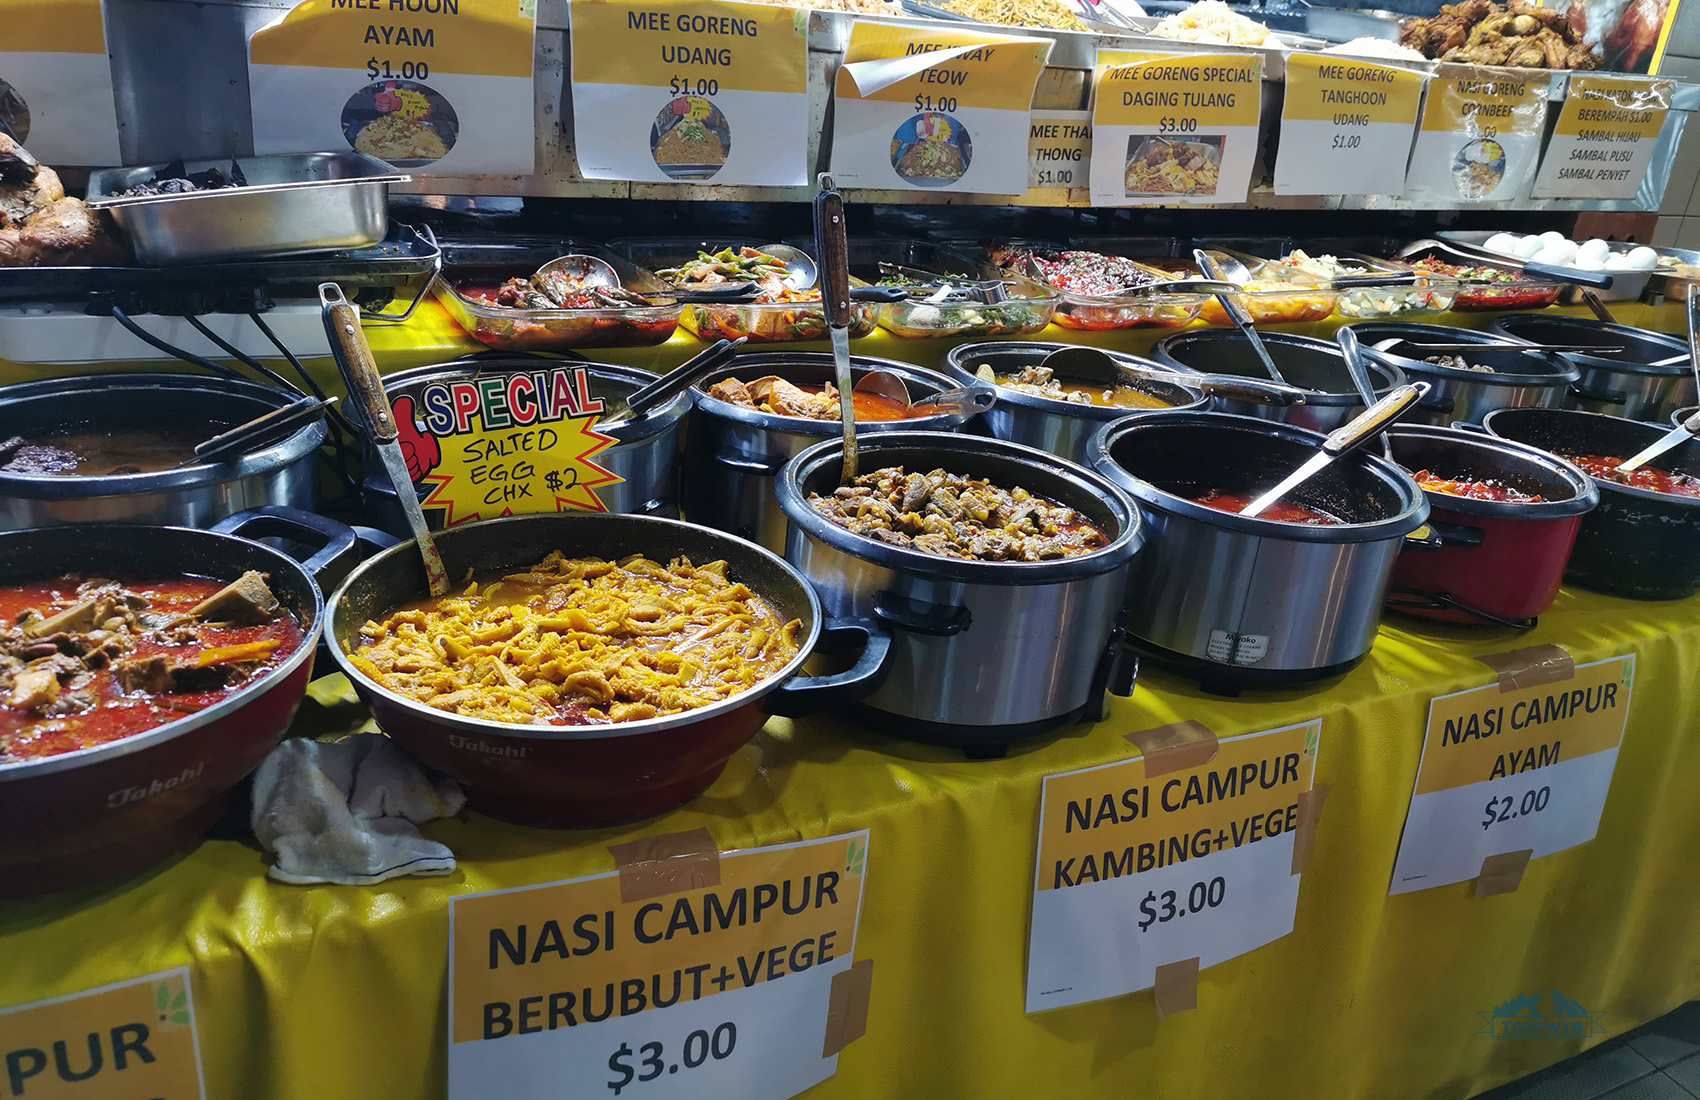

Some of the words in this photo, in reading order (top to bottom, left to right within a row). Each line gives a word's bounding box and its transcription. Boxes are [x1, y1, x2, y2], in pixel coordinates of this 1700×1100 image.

[628, 11, 670, 31] MEE
[677, 14, 757, 37] GORENG
[364, 25, 435, 47] AYAM
[662, 45, 731, 66] UDANG
[947, 45, 995, 62] WAY
[367, 57, 429, 81] $1.00
[920, 68, 968, 86] TEOW
[1110, 66, 1142, 80] MEE
[1142, 66, 1199, 81] GORENG
[1203, 67, 1252, 83] SPECIAL
[1318, 65, 1344, 79] MEE
[1346, 67, 1397, 82] GORENG
[670, 75, 718, 97] $1.00
[1457, 81, 1481, 93] NASI
[1482, 82, 1525, 96] GORENG
[914, 93, 957, 112] $1.00
[1123, 91, 1179, 106] DAGING
[1183, 92, 1236, 107] TULANG
[1321, 89, 1387, 105] TANGHOON
[1333, 113, 1369, 126] UDANG
[1462, 103, 1514, 117] CORNBEEF
[1578, 108, 1628, 122] BEREMPAH
[1629, 111, 1653, 123] $1.00
[1030, 125, 1059, 138] MEE
[1159, 115, 1197, 133] $3.00
[1332, 133, 1361, 149] $1.00
[1577, 129, 1615, 142] SAMBAL
[1616, 131, 1641, 143] HIJAU
[1035, 147, 1082, 162] THONG
[1569, 149, 1608, 161] SAMBAL
[1609, 150, 1634, 162] PUSU
[1038, 170, 1073, 185] $1.00
[1558, 168, 1595, 179] SAMBAL
[1595, 169, 1630, 181] PENYET
[422, 366, 605, 436] SPECIAL
[462, 428, 558, 463] SALTED
[470, 460, 536, 485] EGG
[483, 482, 533, 505] CHX
[544, 467, 582, 492] $2
[1442, 707, 1503, 747] NASI
[1510, 682, 1618, 730] CAMPUR
[449, 734, 526, 757] Takahi
[1489, 741, 1561, 781] AYAM
[1065, 786, 1149, 833] NASI
[1160, 753, 1299, 812] CAMPUR
[1482, 786, 1550, 830] $2.00
[1054, 804, 1299, 889] KAMBING+VEGE
[1138, 876, 1225, 932] $3.00
[488, 910, 614, 969] NASI
[633, 871, 839, 944] CAMPUR
[483, 930, 837, 1040] BERUBUT+VEGE
[607, 1021, 737, 1096] $3.00
